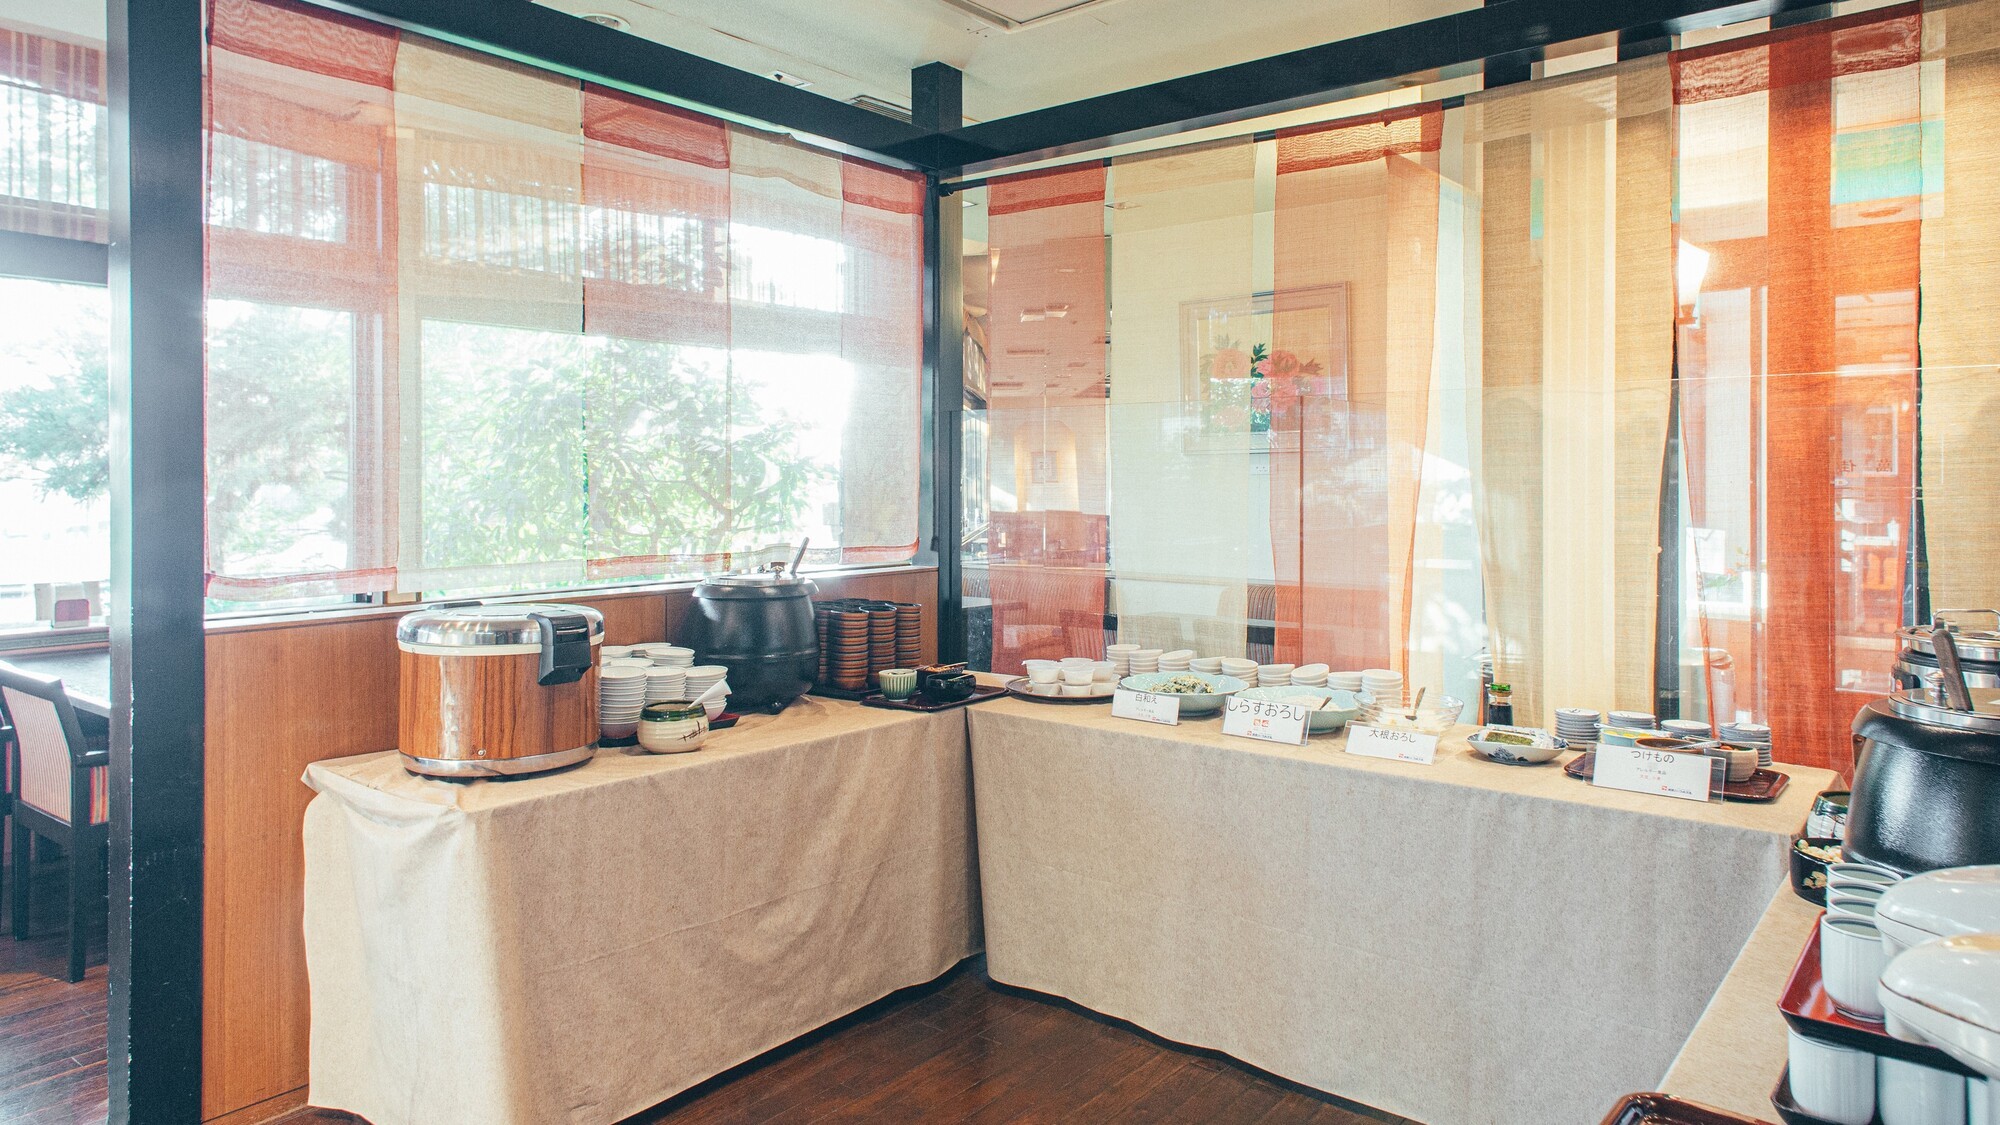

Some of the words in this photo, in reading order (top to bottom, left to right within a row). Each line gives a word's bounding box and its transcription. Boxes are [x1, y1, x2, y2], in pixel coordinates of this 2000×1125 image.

[1135, 693, 1158, 705] 白和え
[1227, 697, 1305, 722] しらすおろし
[1368, 728, 1417, 744] 大根おろし
[1630, 750, 1675, 764] つけもの
